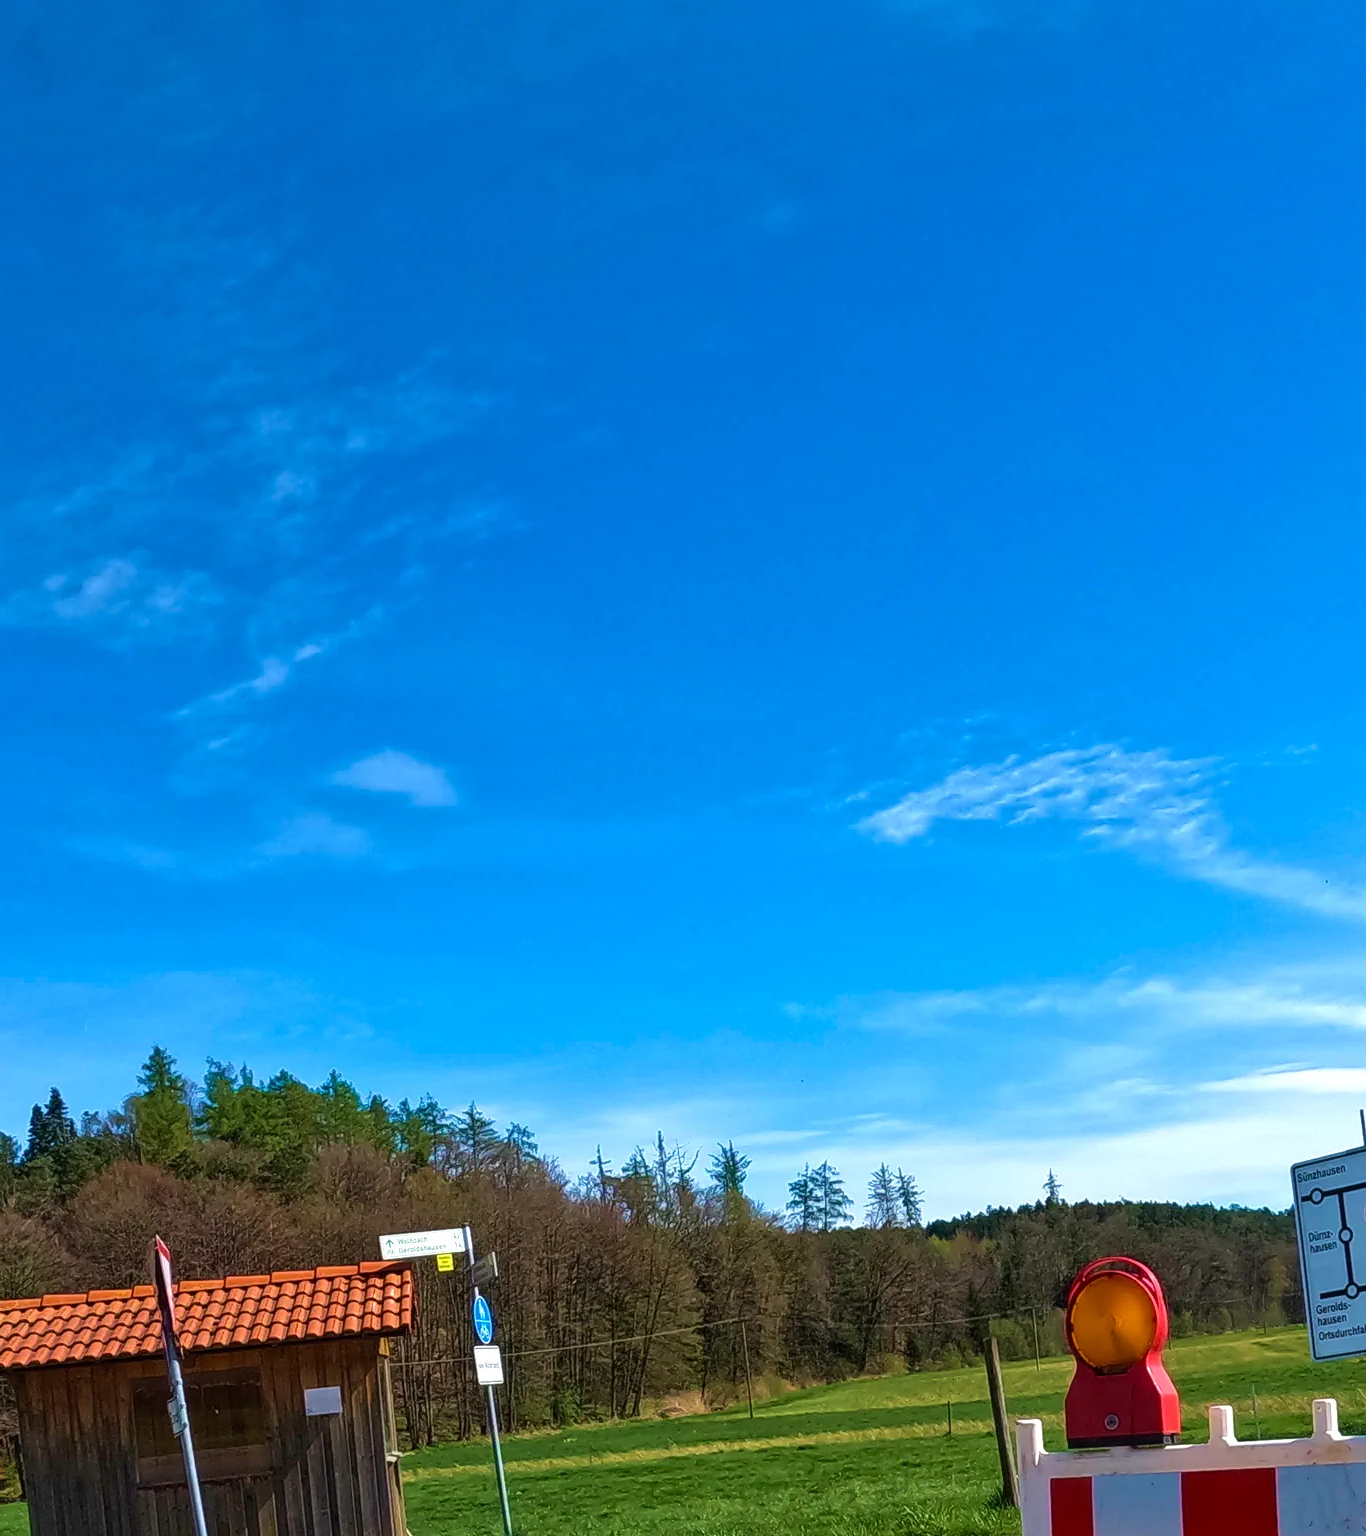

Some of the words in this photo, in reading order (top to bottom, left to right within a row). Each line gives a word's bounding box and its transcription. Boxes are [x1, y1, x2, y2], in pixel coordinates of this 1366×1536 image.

[1297, 1165, 1347, 1183] Sünzhausen
[1309, 1241, 1337, 1254] hausen
[1315, 1301, 1351, 1315] Gerolds-
[1317, 1314, 1347, 1326] hausen
